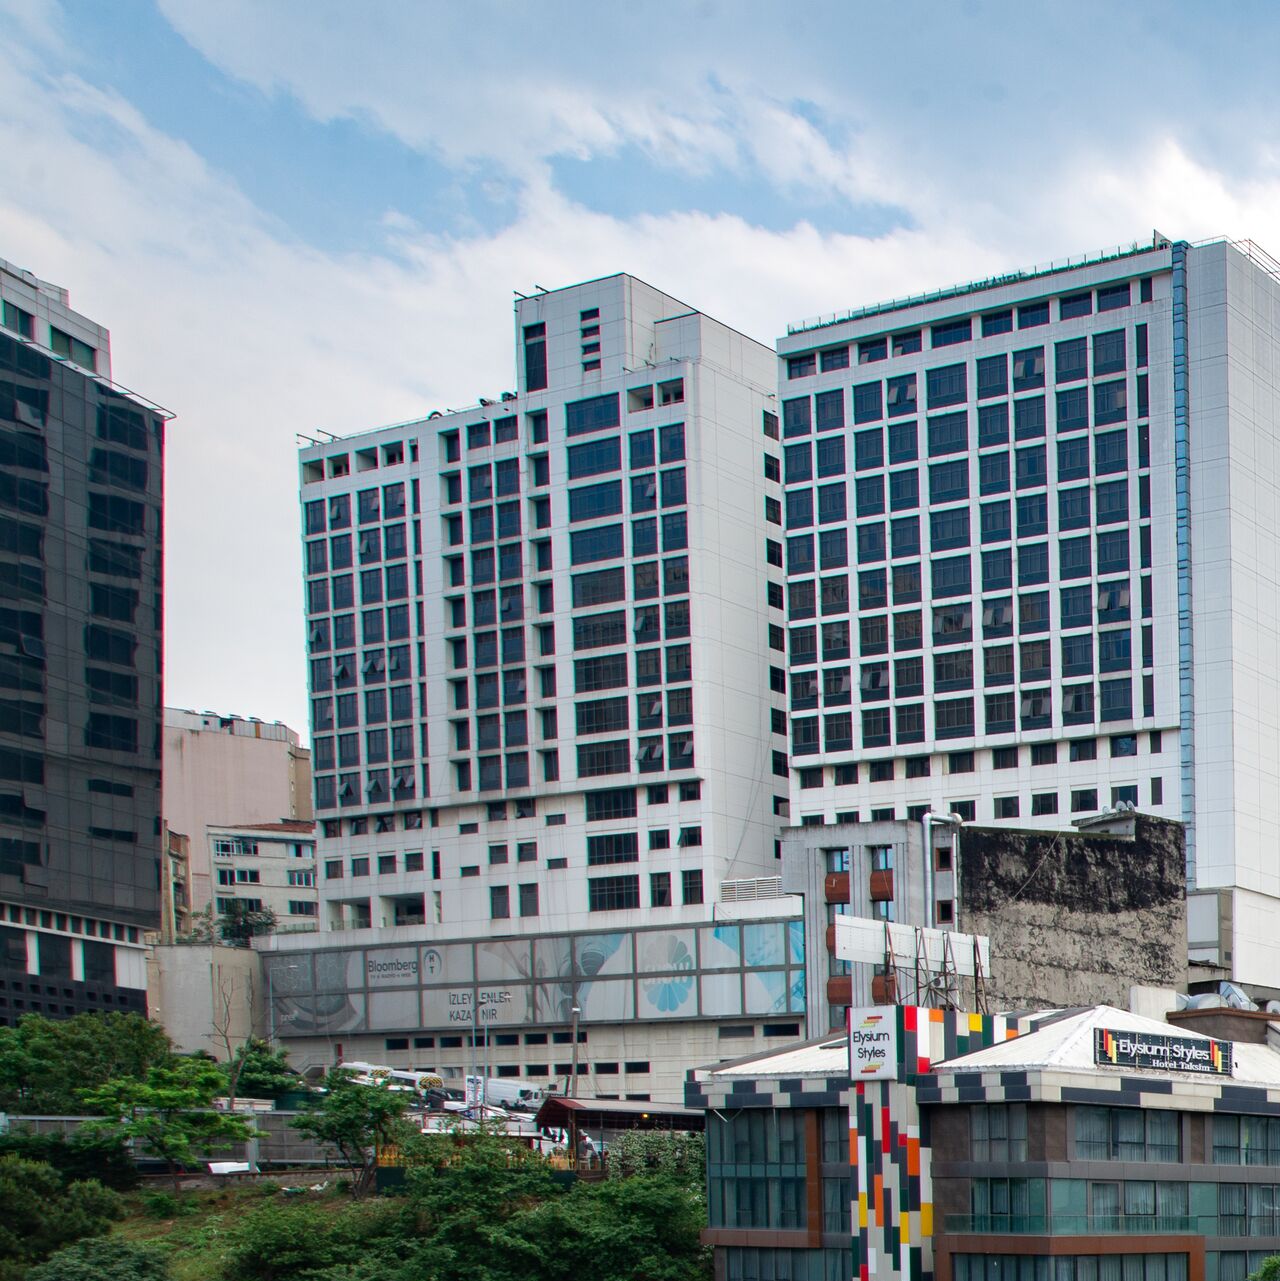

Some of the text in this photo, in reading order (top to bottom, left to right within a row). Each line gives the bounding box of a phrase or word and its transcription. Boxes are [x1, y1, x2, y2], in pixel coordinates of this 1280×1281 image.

[368, 959, 418, 974] Bloomberg
[853, 1030, 890, 1045] Elysium
[857, 1046, 886, 1061] Styles
[1119, 1039, 1210, 1062] Elysium Styles
[1152, 1059, 1211, 1072] Hotel Taksim
